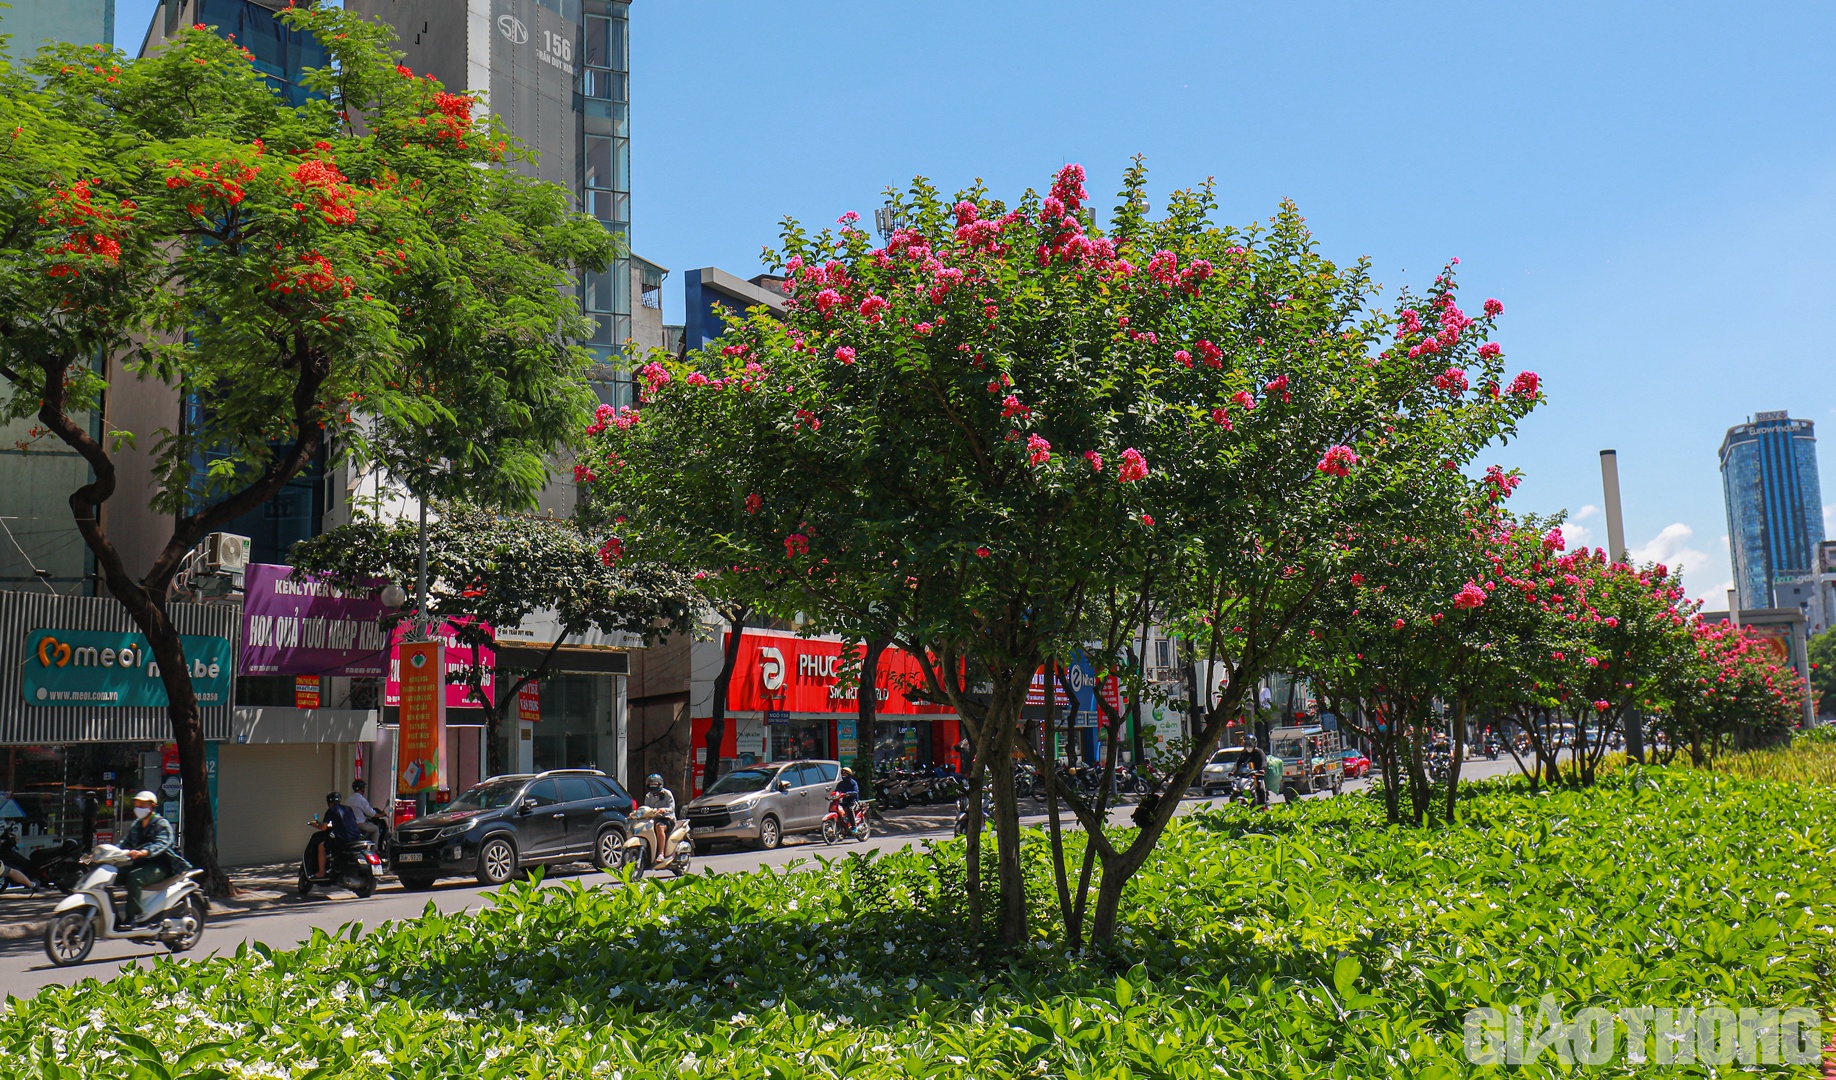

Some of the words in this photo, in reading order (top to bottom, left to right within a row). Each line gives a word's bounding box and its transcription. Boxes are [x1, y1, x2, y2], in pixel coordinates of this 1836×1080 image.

[544, 30, 571, 61] 156
[551, 57, 562, 70] DUY
[250, 615, 273, 647] HOA
[276, 607, 299, 651] QUẢ
[327, 614, 358, 656] NHẬP
[73, 643, 142, 668] meoi
[50, 691, 118, 701] www.meoi.com.vn
